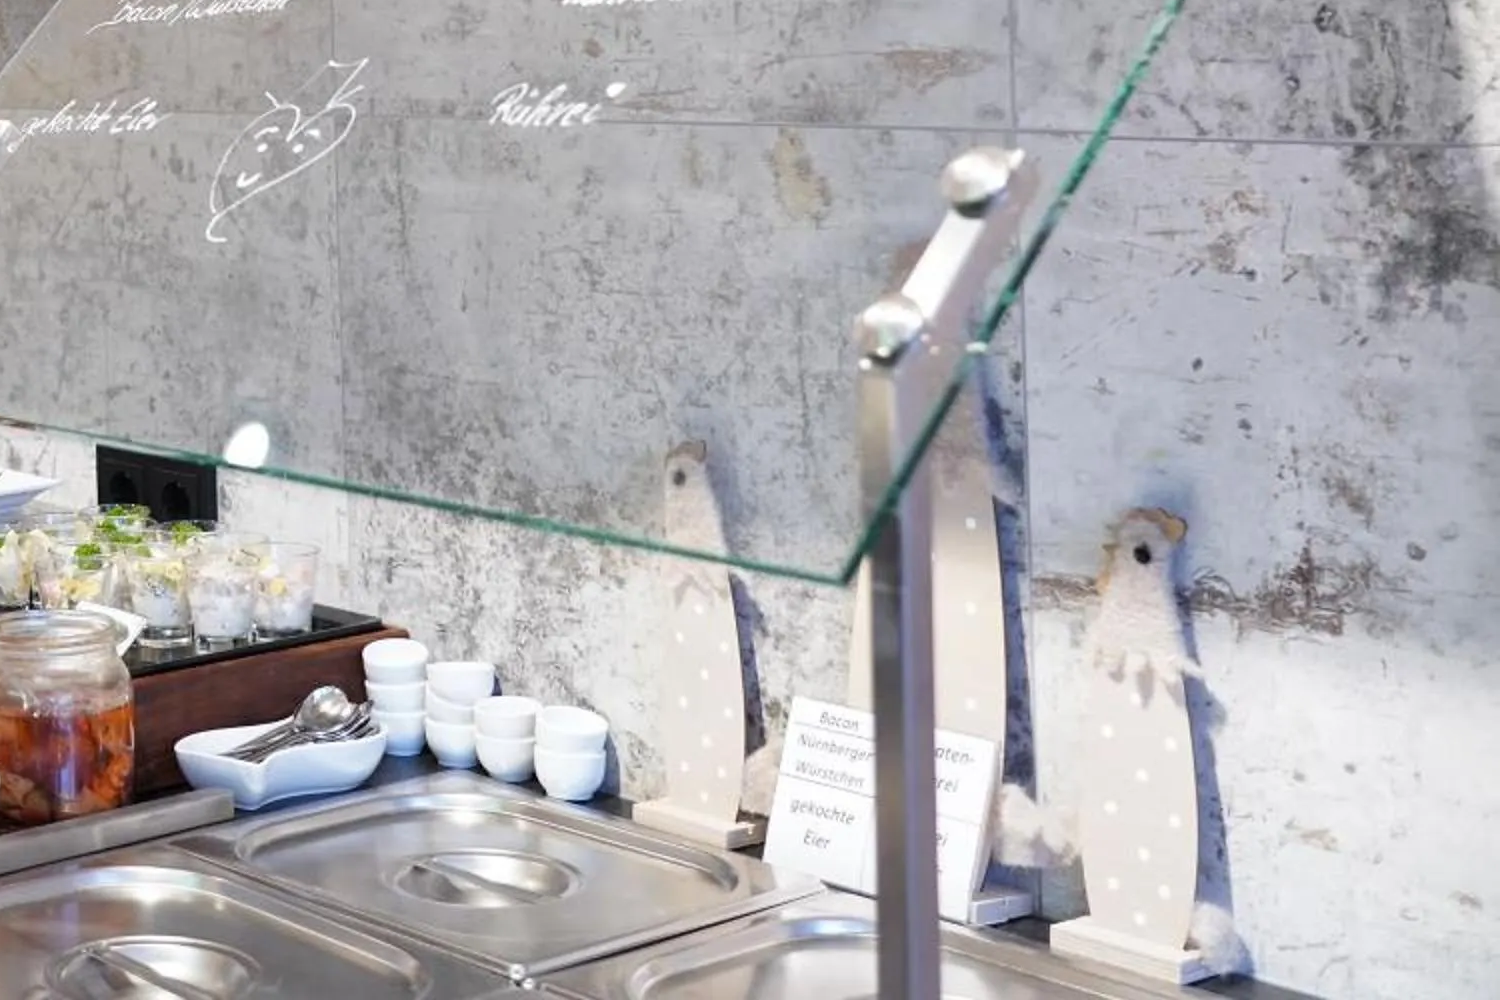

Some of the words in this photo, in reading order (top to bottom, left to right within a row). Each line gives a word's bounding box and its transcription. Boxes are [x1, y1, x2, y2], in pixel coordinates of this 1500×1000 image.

[488, 82, 627, 128] Rührei
[789, 797, 856, 826] gekochte
[803, 829, 831, 850] Eier
